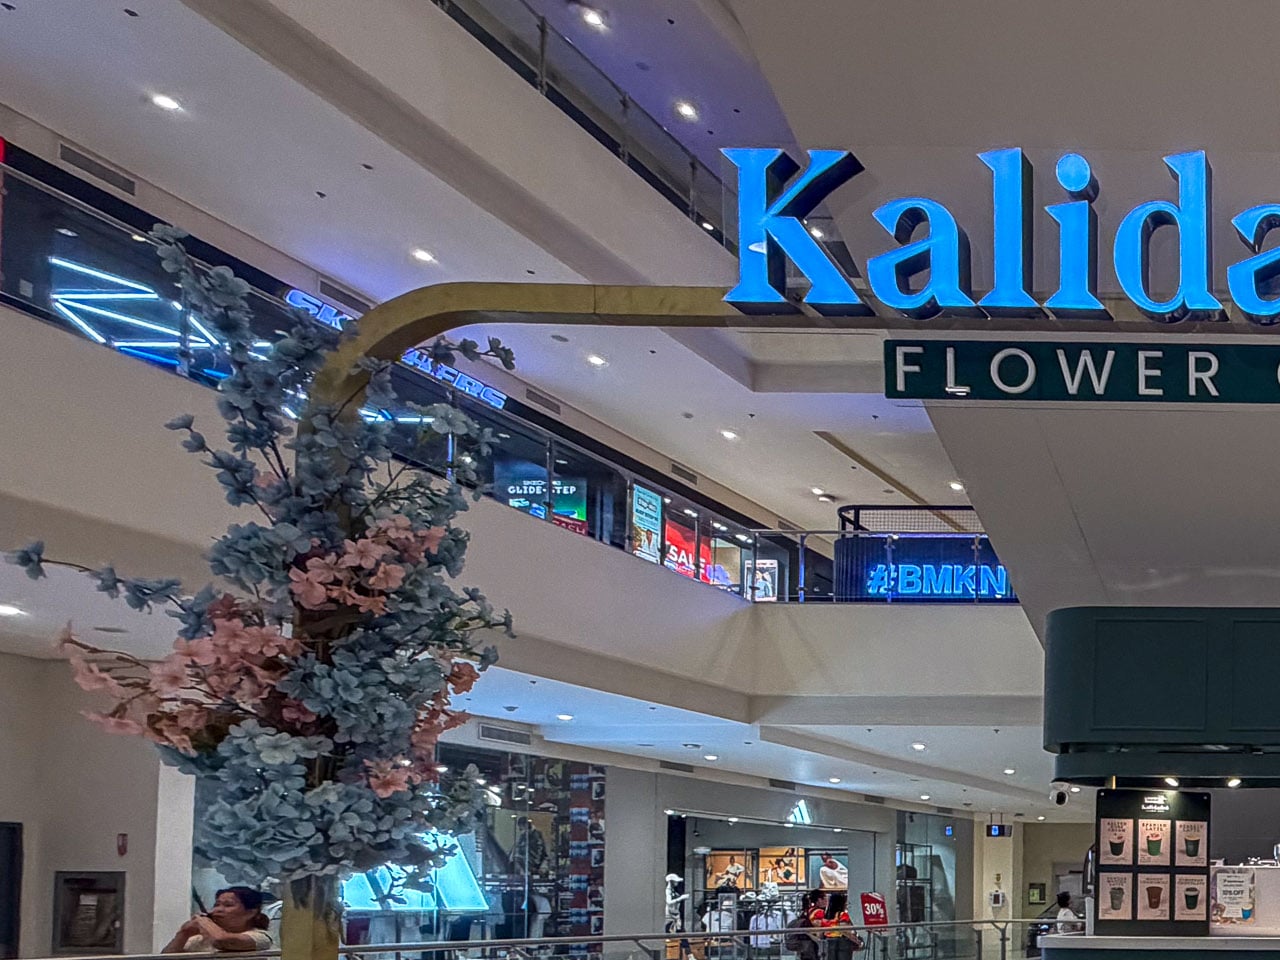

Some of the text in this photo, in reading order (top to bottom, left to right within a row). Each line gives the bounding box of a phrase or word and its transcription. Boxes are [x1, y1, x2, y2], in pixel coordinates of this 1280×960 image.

[893, 344, 1221, 398] FLOWER
[507, 486, 576, 495] GLIDE-TEP
[668, 545, 706, 574] SALE
[864, 903, 885, 916] 30%
